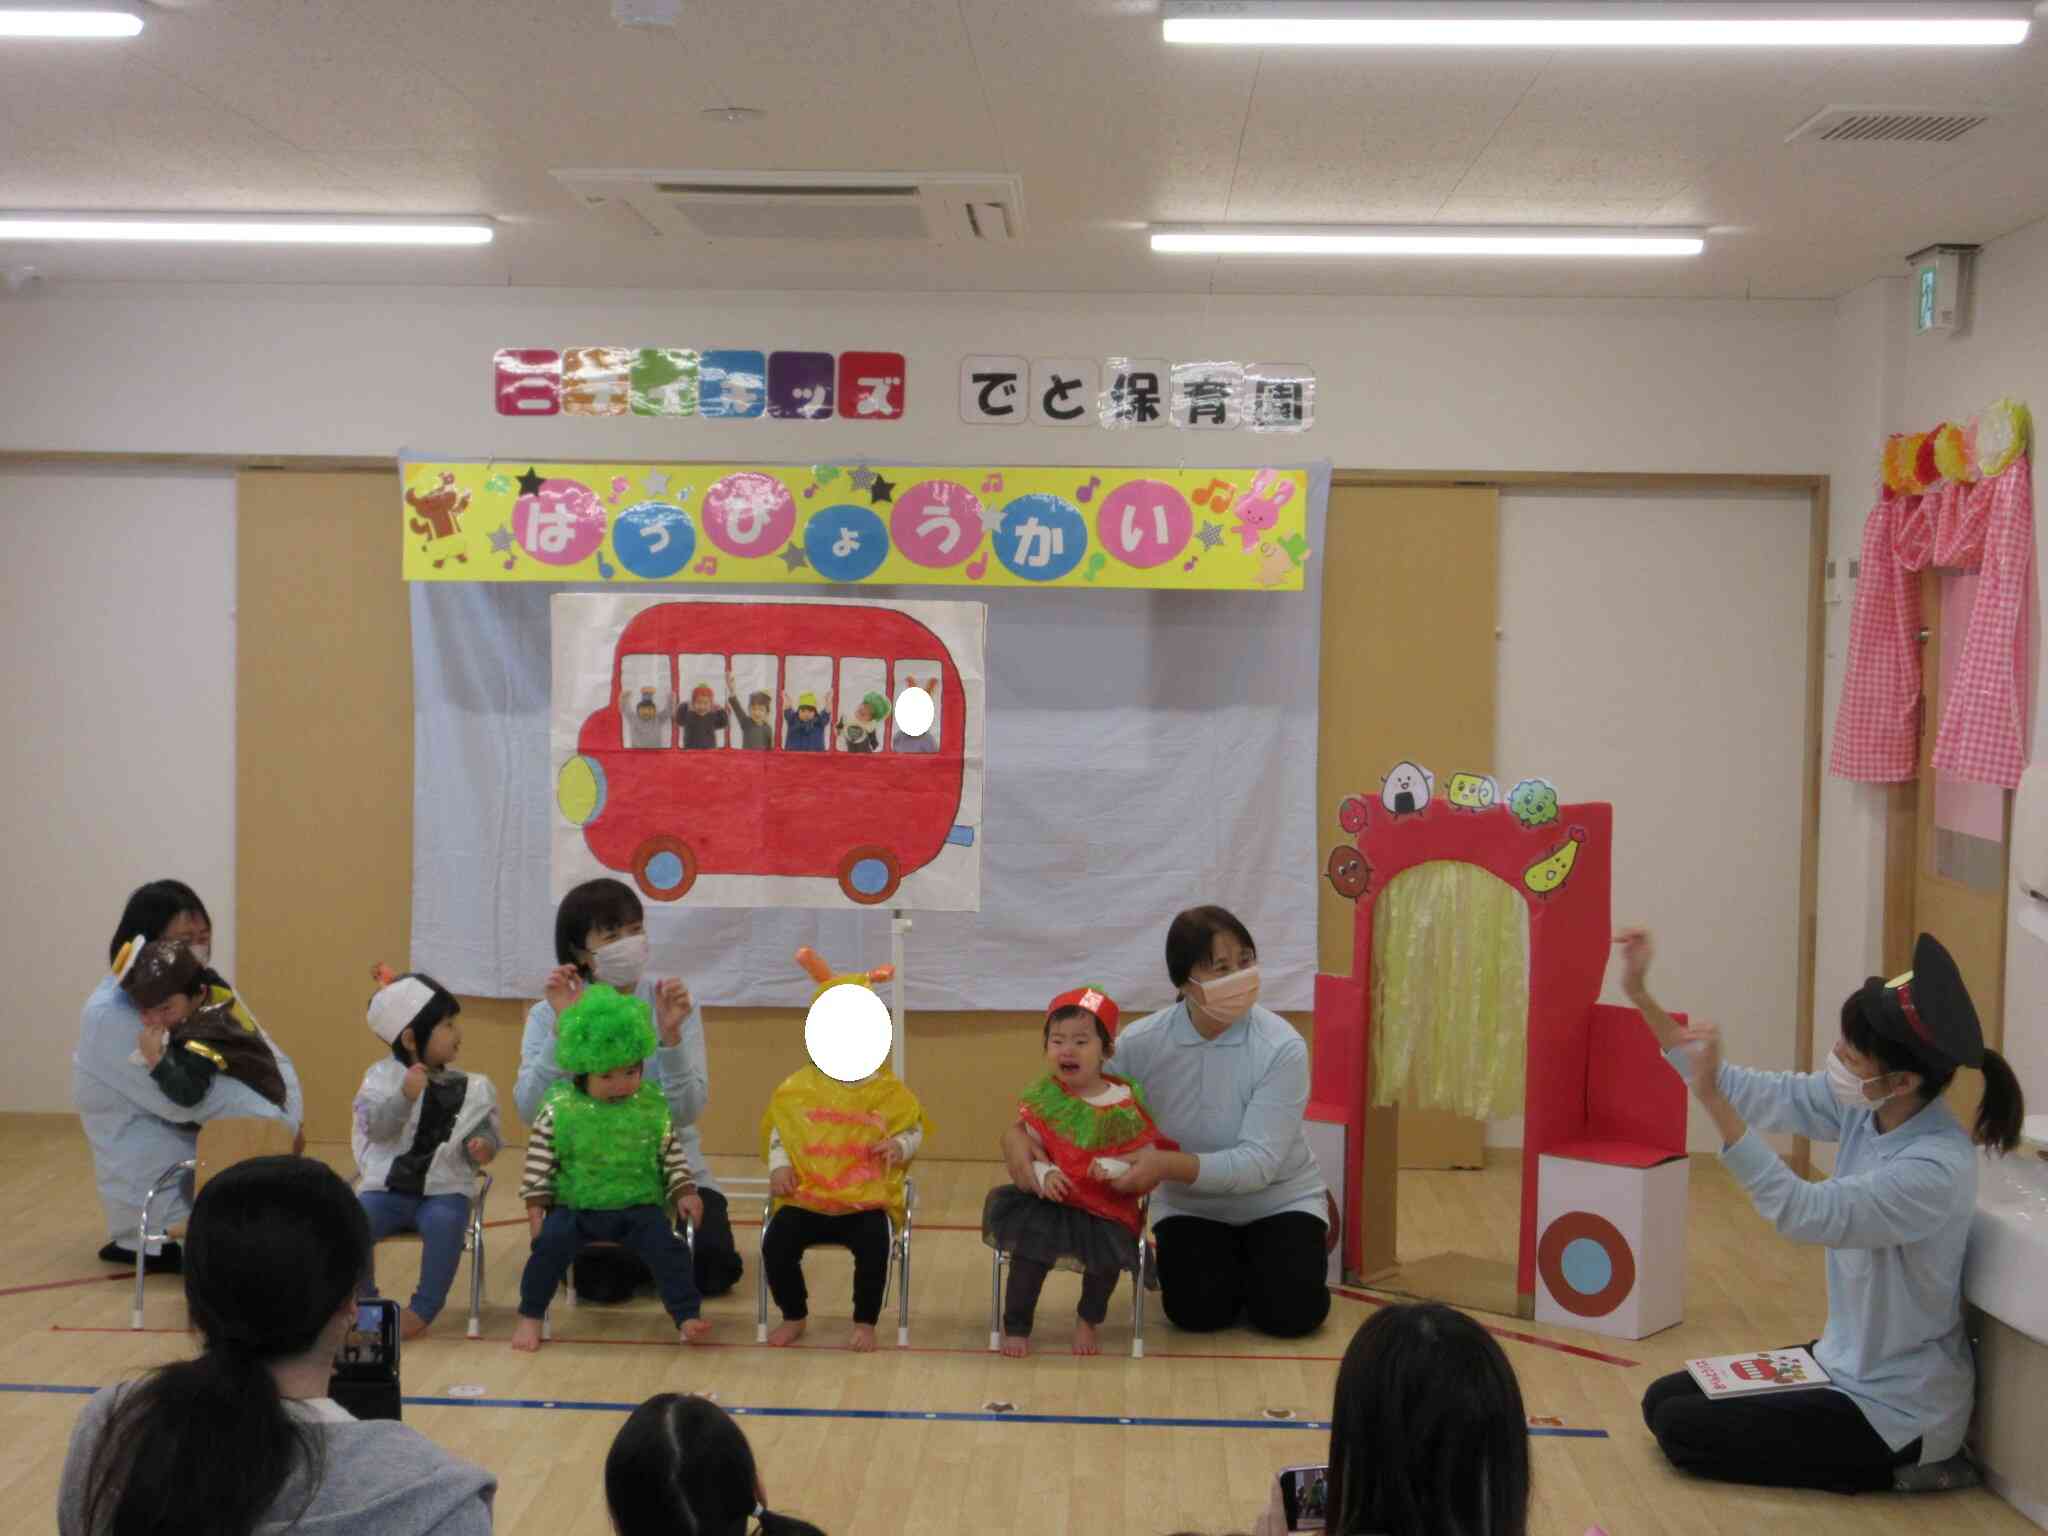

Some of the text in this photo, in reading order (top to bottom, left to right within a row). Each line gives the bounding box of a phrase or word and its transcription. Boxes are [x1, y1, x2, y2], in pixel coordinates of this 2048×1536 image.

[971, 372, 1304, 424] でと保育園
[525, 495, 1170, 568] はっぴょうかい
